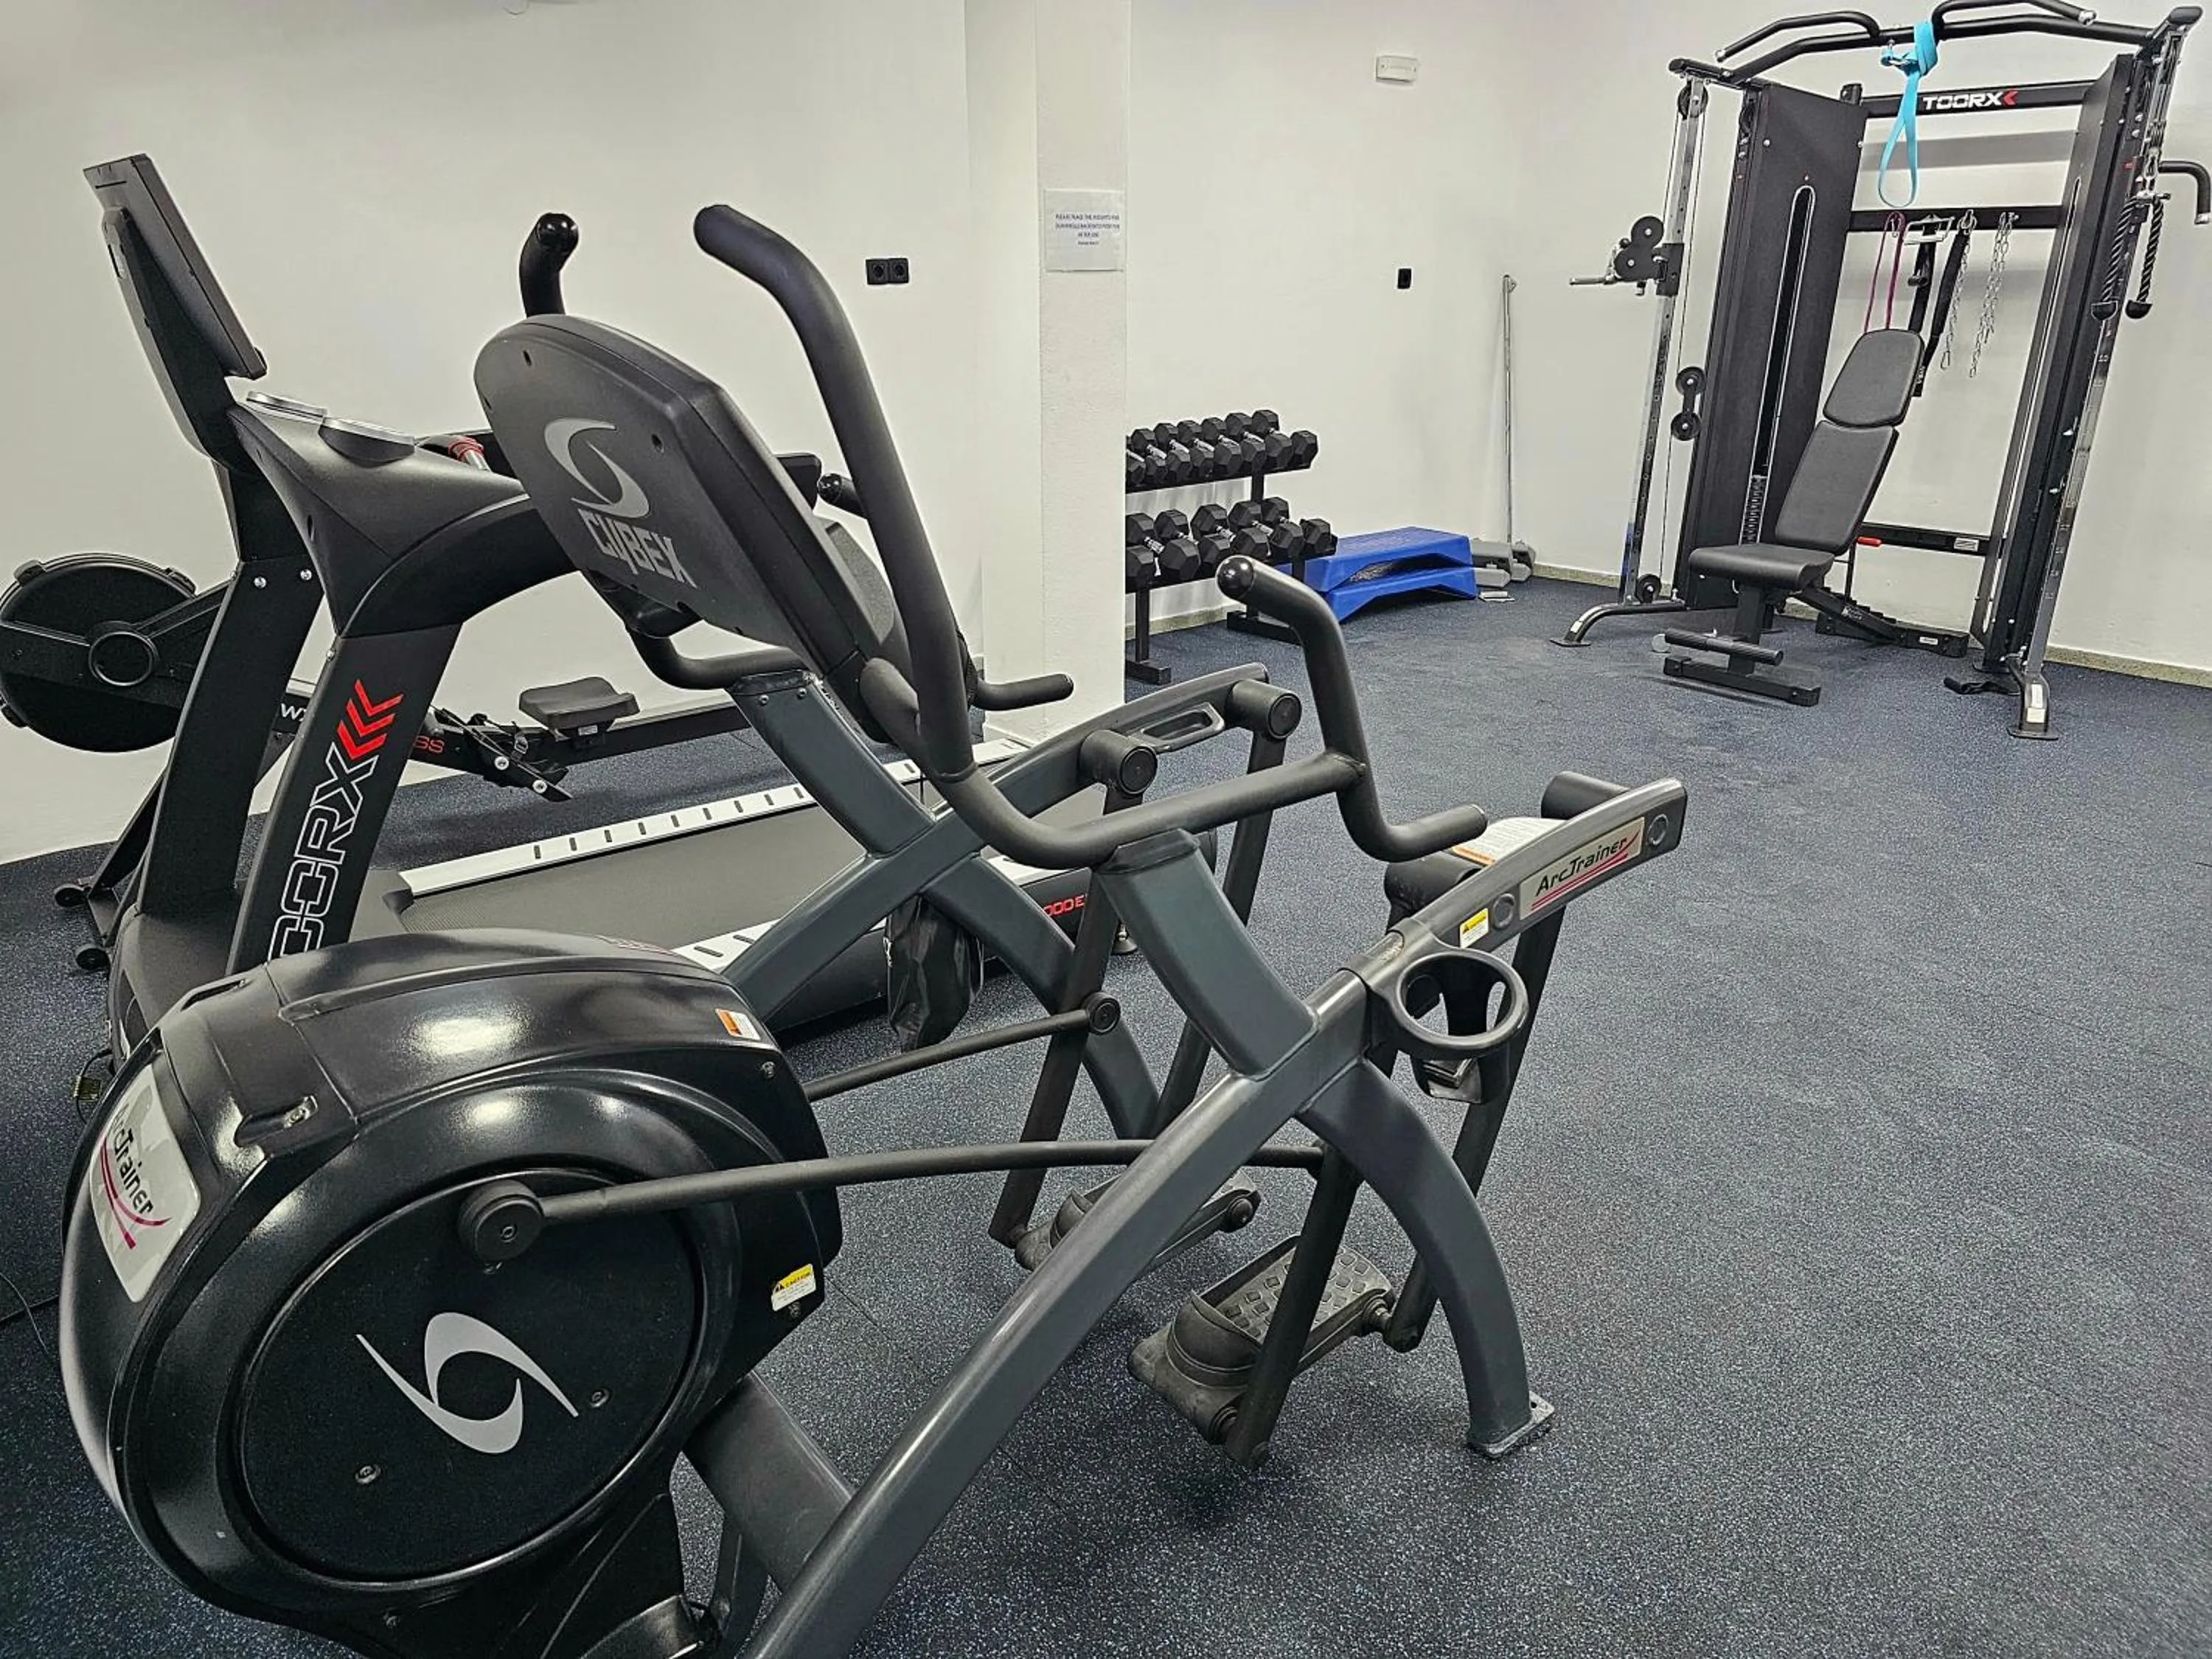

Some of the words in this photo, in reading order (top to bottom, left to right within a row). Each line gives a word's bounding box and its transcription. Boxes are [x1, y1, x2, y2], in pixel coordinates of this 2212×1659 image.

[1922, 91, 2003, 110] TOORX
[578, 507, 698, 589] CYBEX
[268, 741, 379, 960] OORX
[1535, 837, 1627, 897] ArcTrainer
